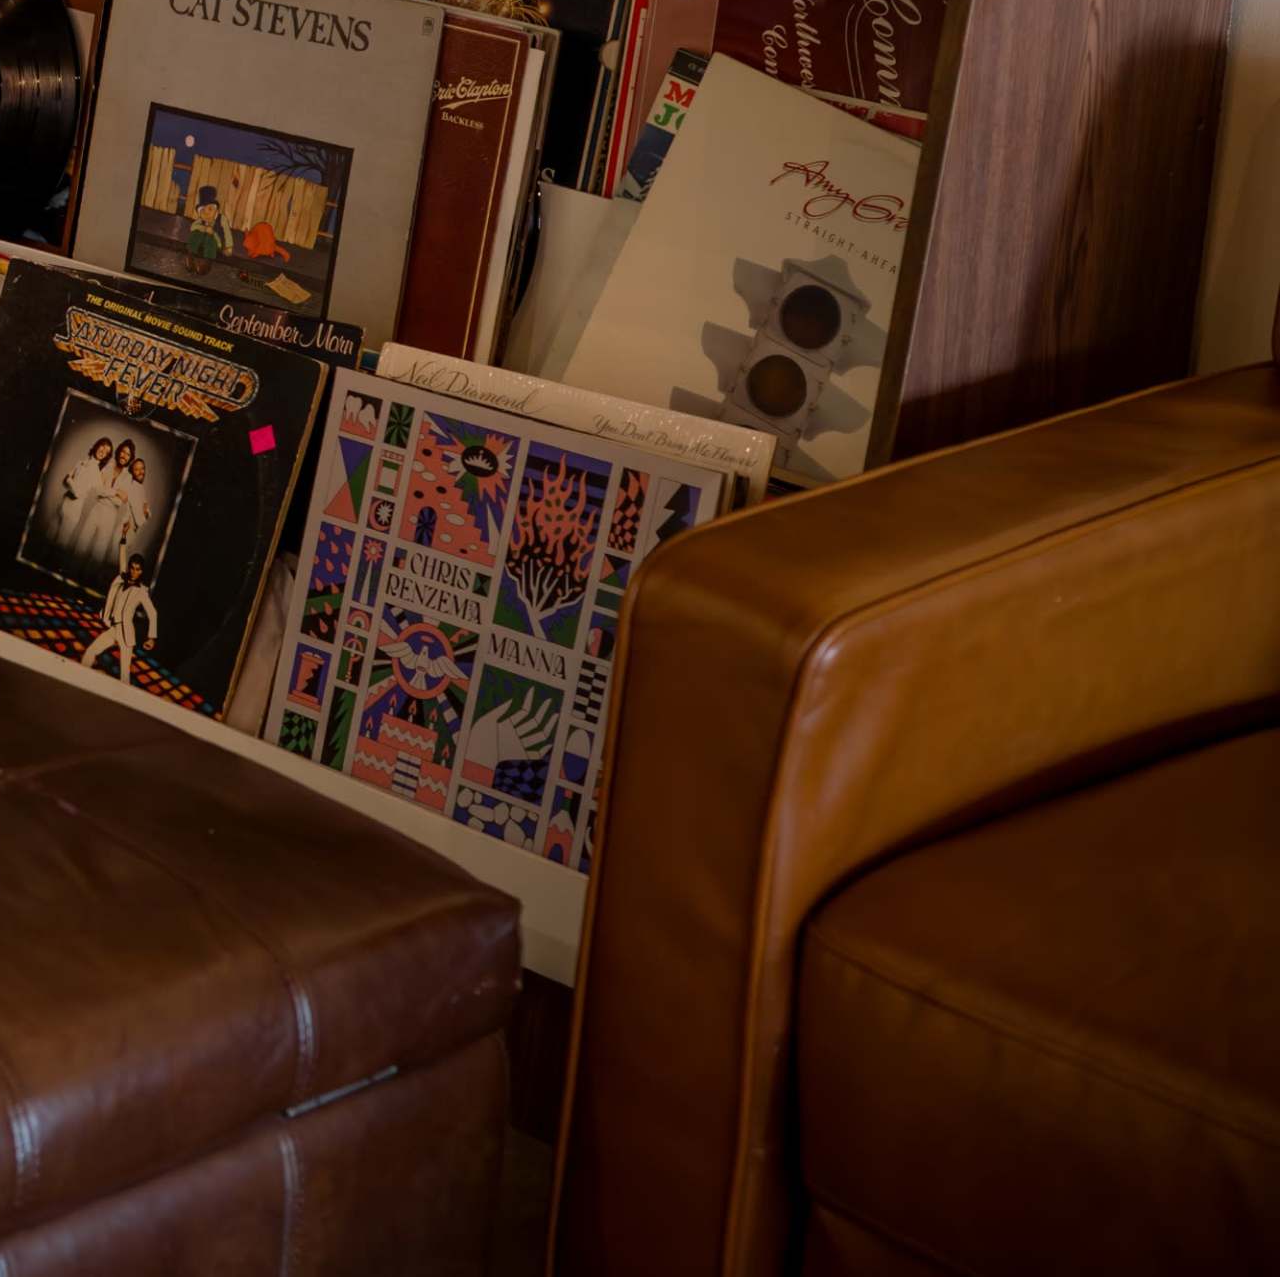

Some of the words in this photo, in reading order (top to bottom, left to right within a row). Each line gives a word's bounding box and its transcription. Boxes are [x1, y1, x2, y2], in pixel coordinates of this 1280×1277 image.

[456, 76, 513, 103] Clapton
[85, 293, 103, 306] THE
[103, 297, 143, 321] ORIGINAL
[143, 312, 172, 331] MOVIE
[172, 323, 203, 342] SOUND
[203, 334, 235, 353] TRACK
[217, 303, 300, 346] September
[103, 356, 188, 404] FEVER
[392, 360, 445, 389] Neil
[441, 370, 547, 414] Diamond
[410, 552, 471, 591] CHRIS
[386, 573, 482, 625] RENZEMA
[491, 633, 567, 680] MANNA
